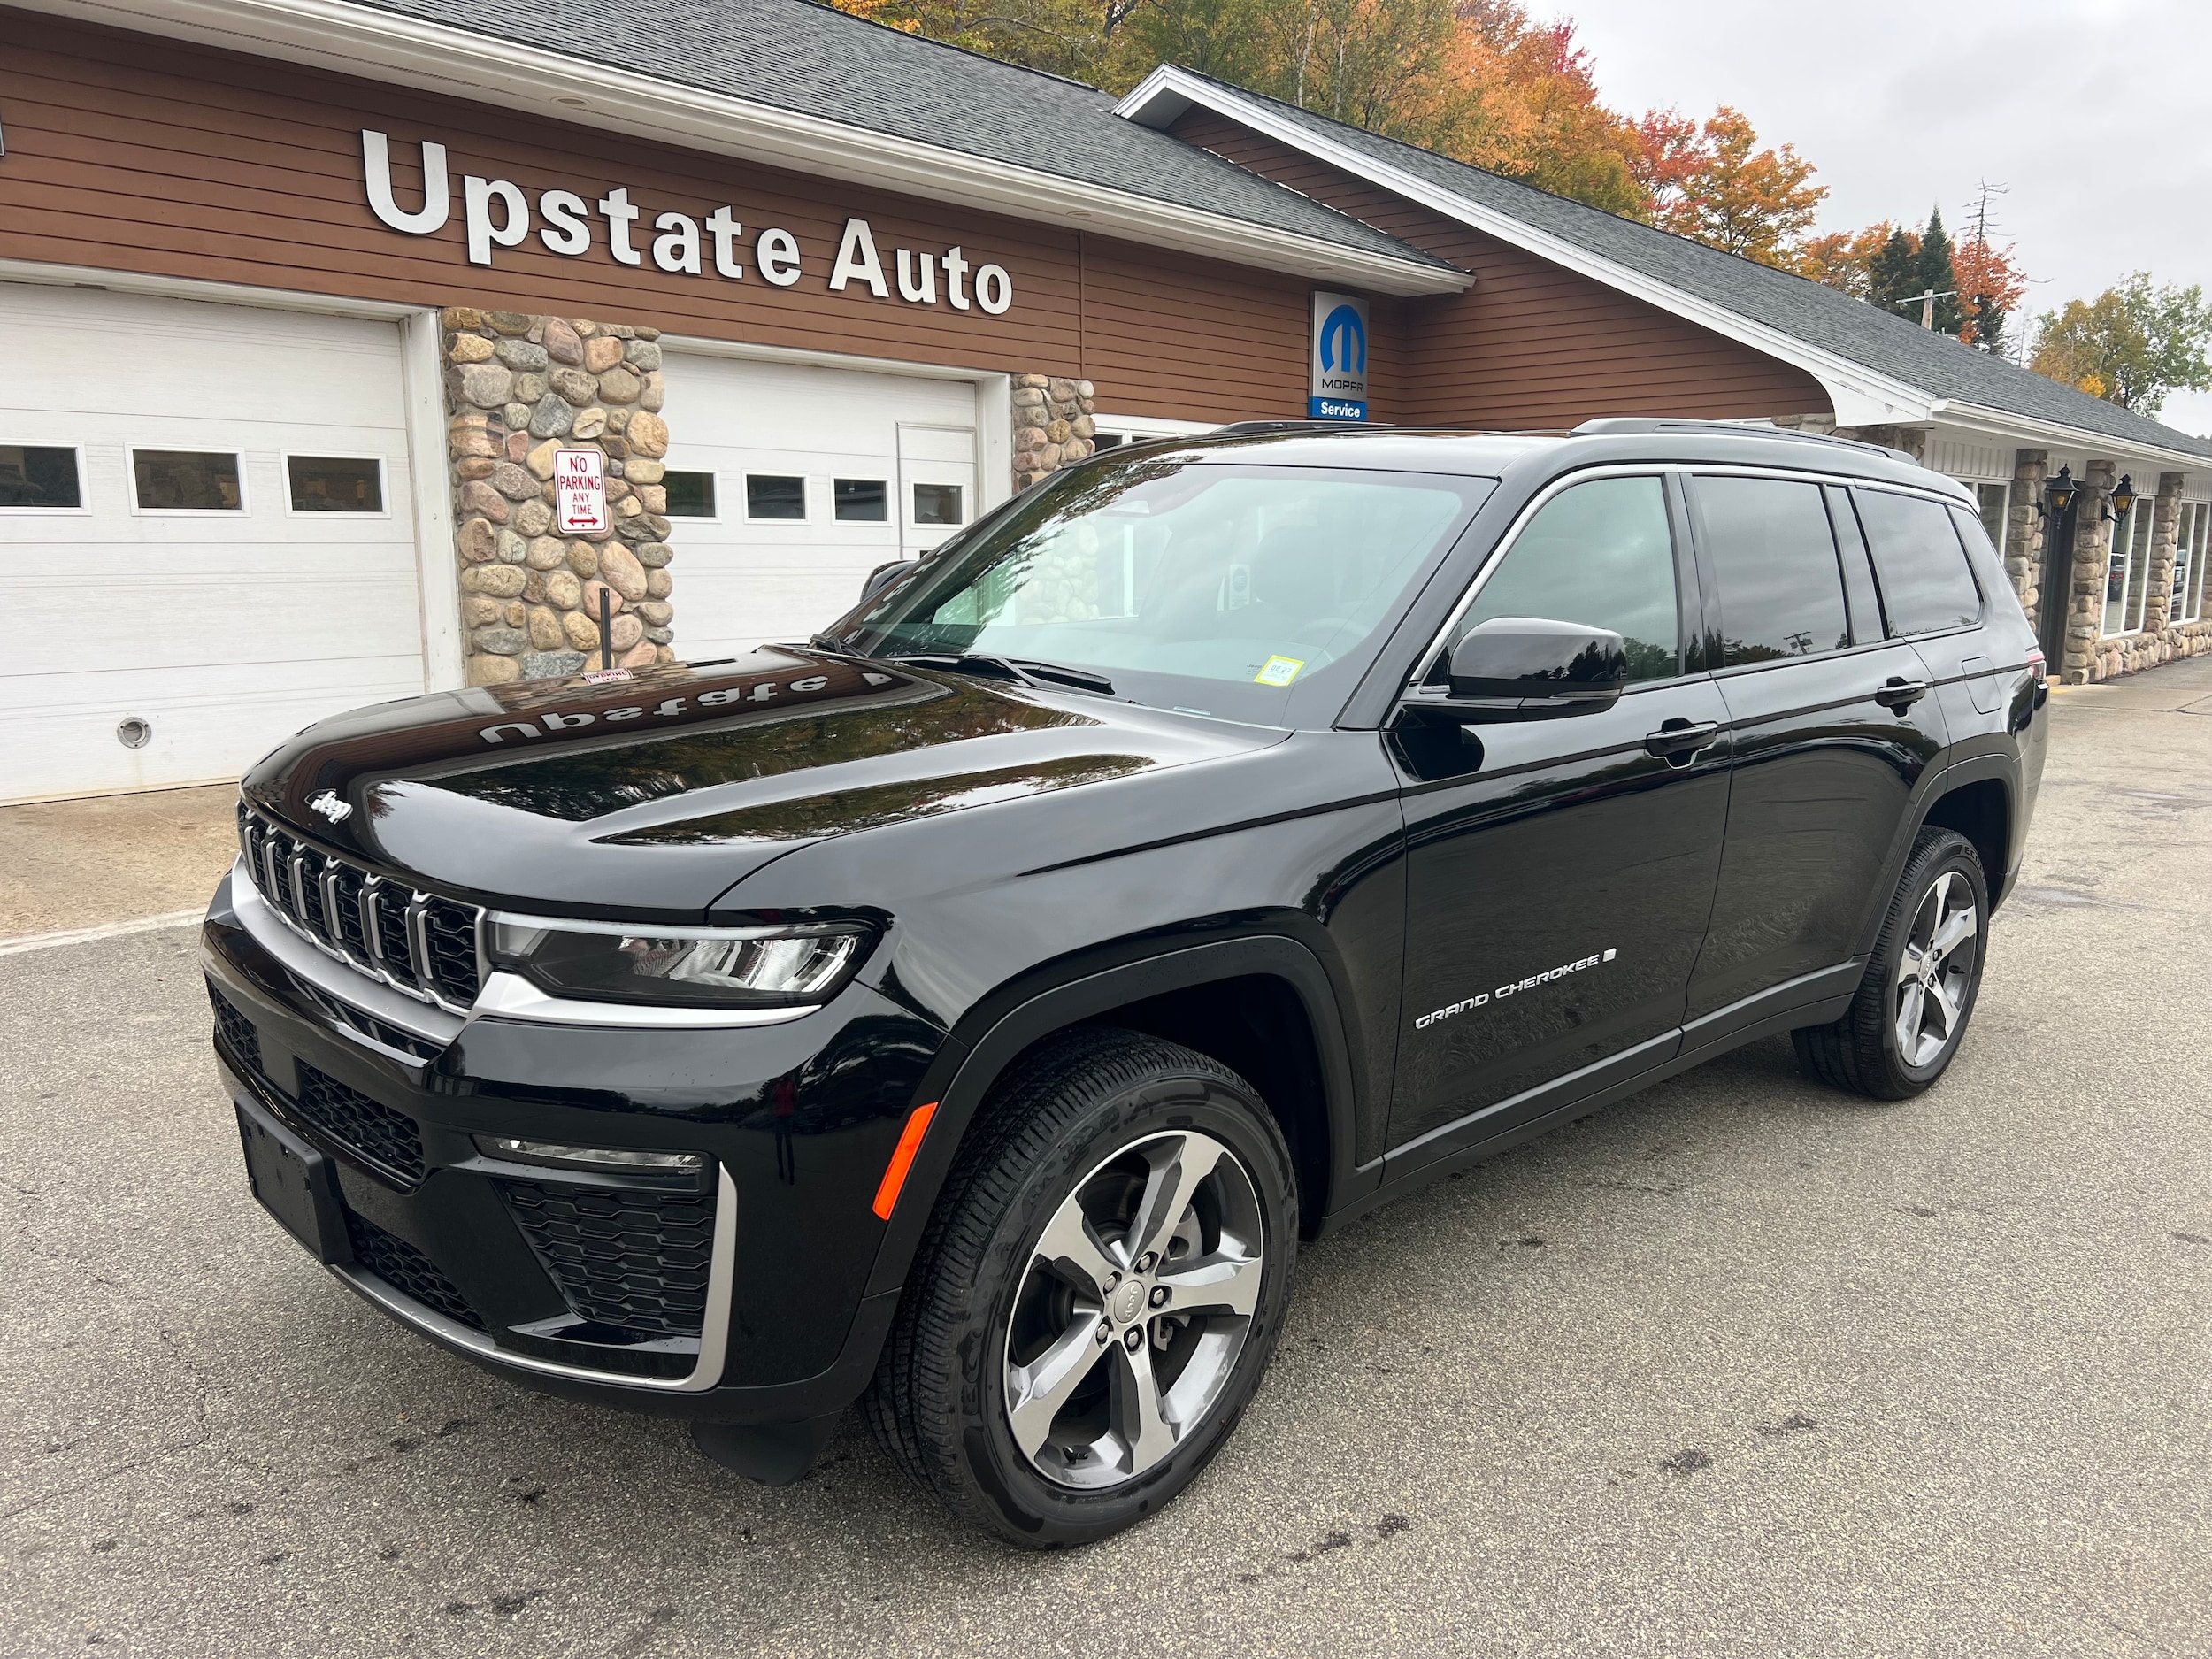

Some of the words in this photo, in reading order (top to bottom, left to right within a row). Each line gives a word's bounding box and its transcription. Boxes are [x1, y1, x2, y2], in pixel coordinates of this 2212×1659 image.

[360, 127, 803, 288] Upstate
[828, 217, 1014, 316] Auto
[1322, 378, 1363, 393] MOPAR
[1320, 401, 1361, 418] Service
[569, 457, 588, 472] NO
[559, 475, 601, 490] PARKING
[572, 493, 589, 503] ANY
[572, 504, 593, 515] TIME
[311, 790, 352, 823] Jeep
[1415, 993, 1489, 1029] GRAND
[1495, 954, 1600, 999] CHEROKEE
